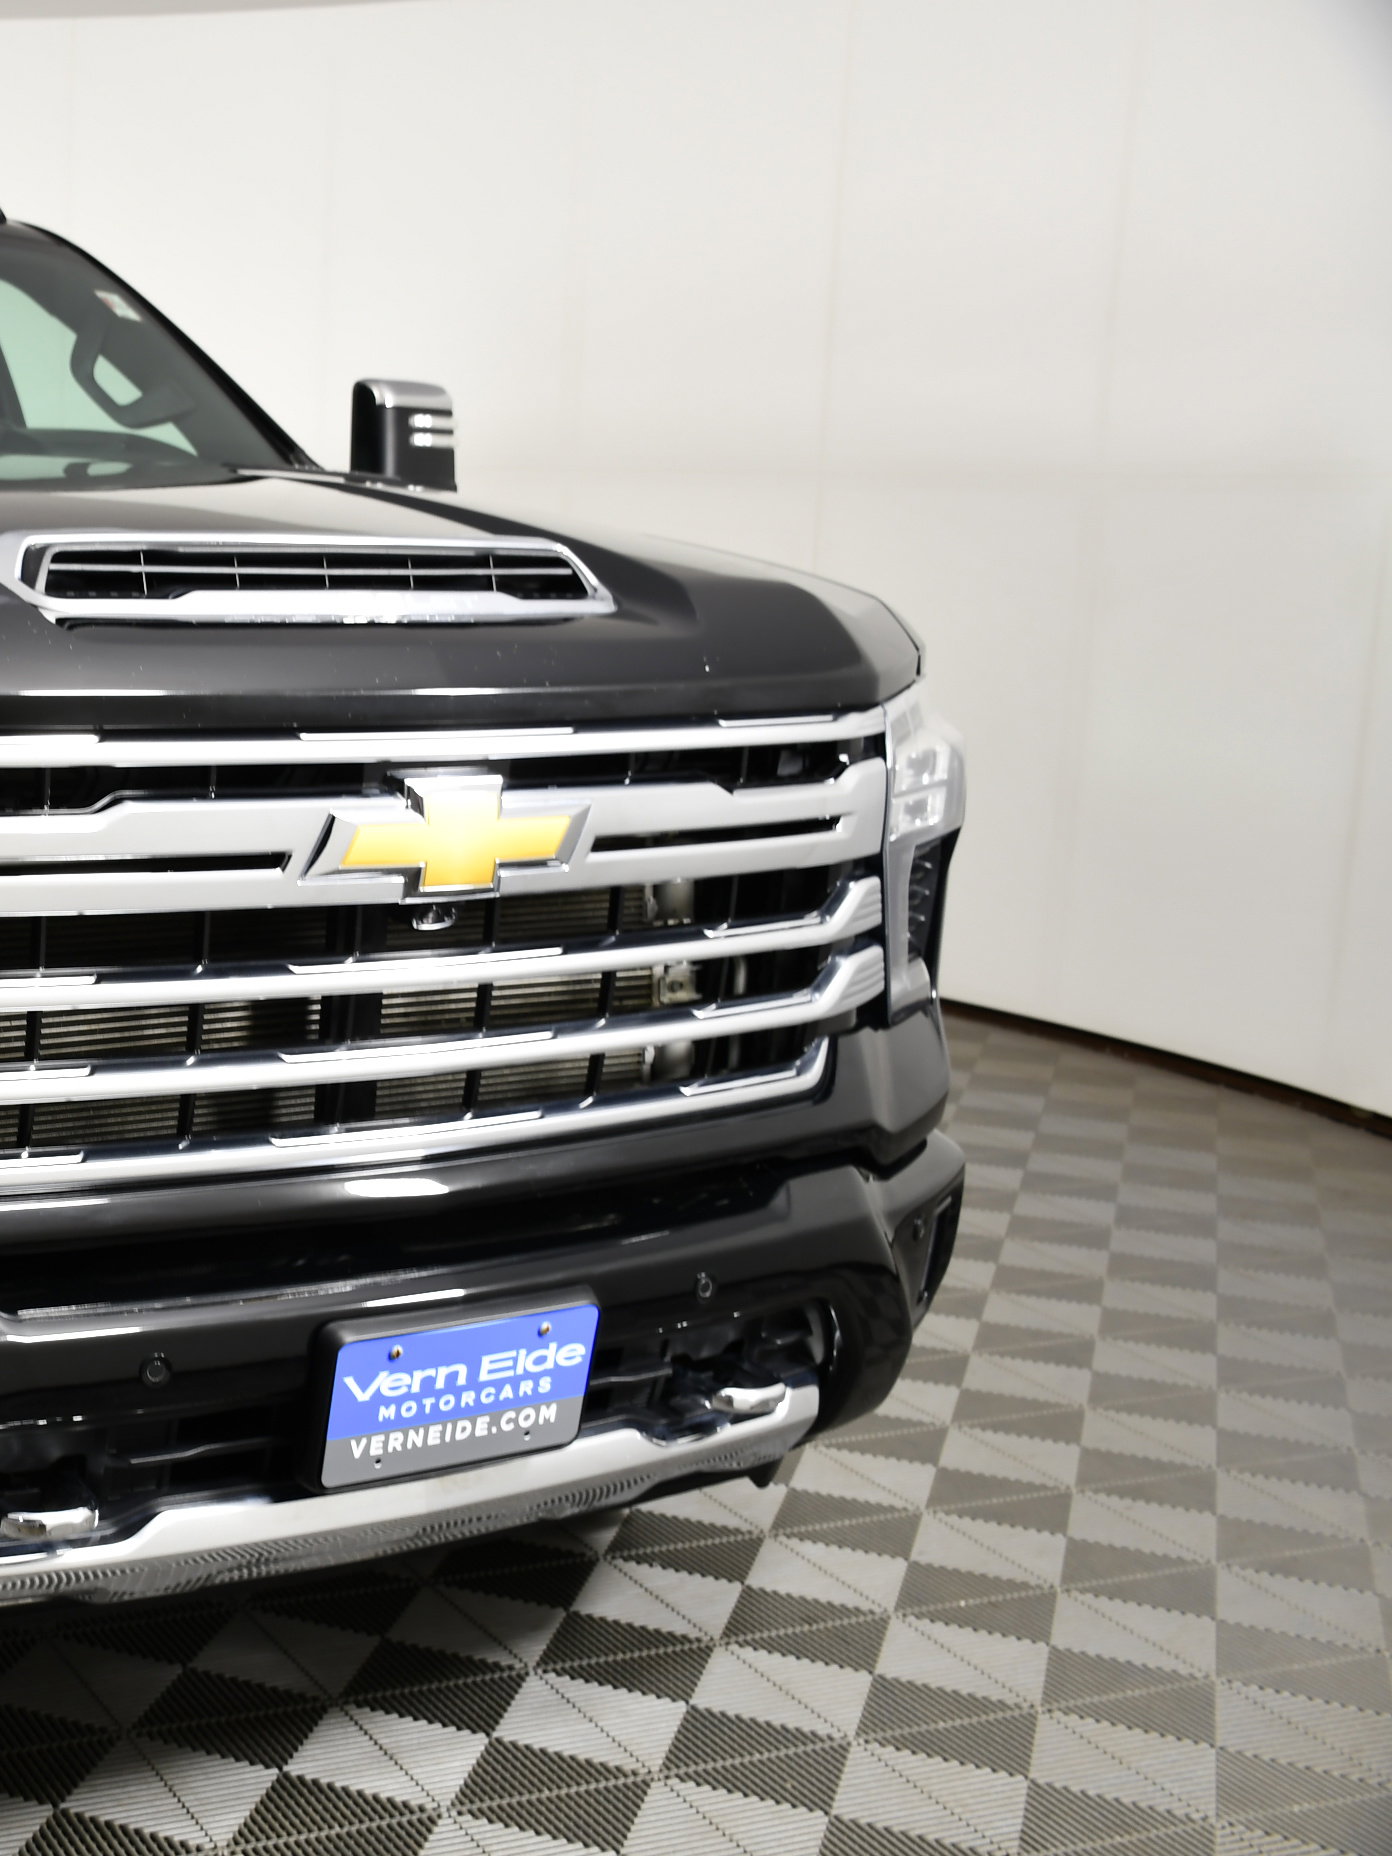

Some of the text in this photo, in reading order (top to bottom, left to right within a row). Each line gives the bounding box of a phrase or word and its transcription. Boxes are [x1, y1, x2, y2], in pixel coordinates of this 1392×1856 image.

[343, 1363, 467, 1402] Vern
[378, 1376, 552, 1422] MOTORCARS
[350, 1402, 557, 1459] VERNEIDE.COM
